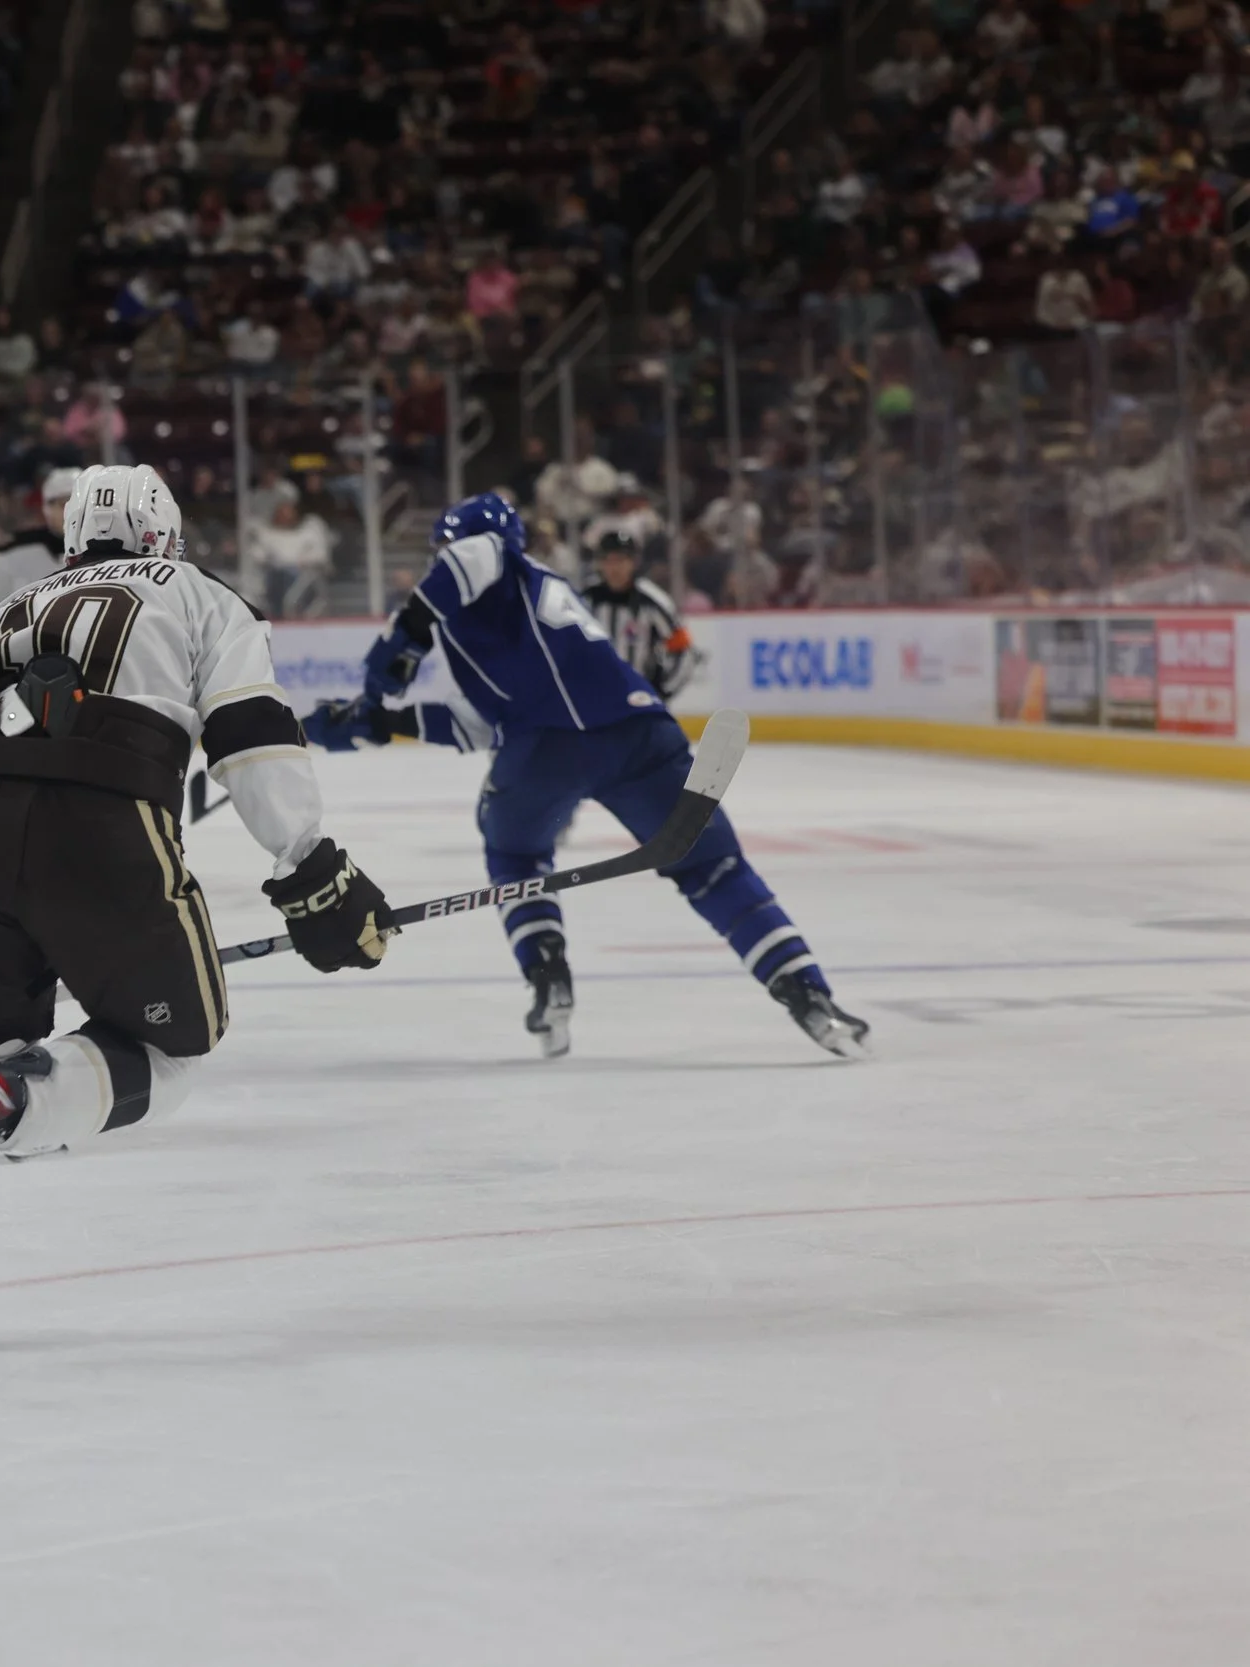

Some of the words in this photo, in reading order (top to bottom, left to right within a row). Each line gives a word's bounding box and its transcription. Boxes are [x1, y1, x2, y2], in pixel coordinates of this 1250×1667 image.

[95, 487, 115, 507] 10
[750, 637, 875, 691] ECOLAB
[280, 856, 359, 920] CCM
[423, 876, 547, 921] BAUER
